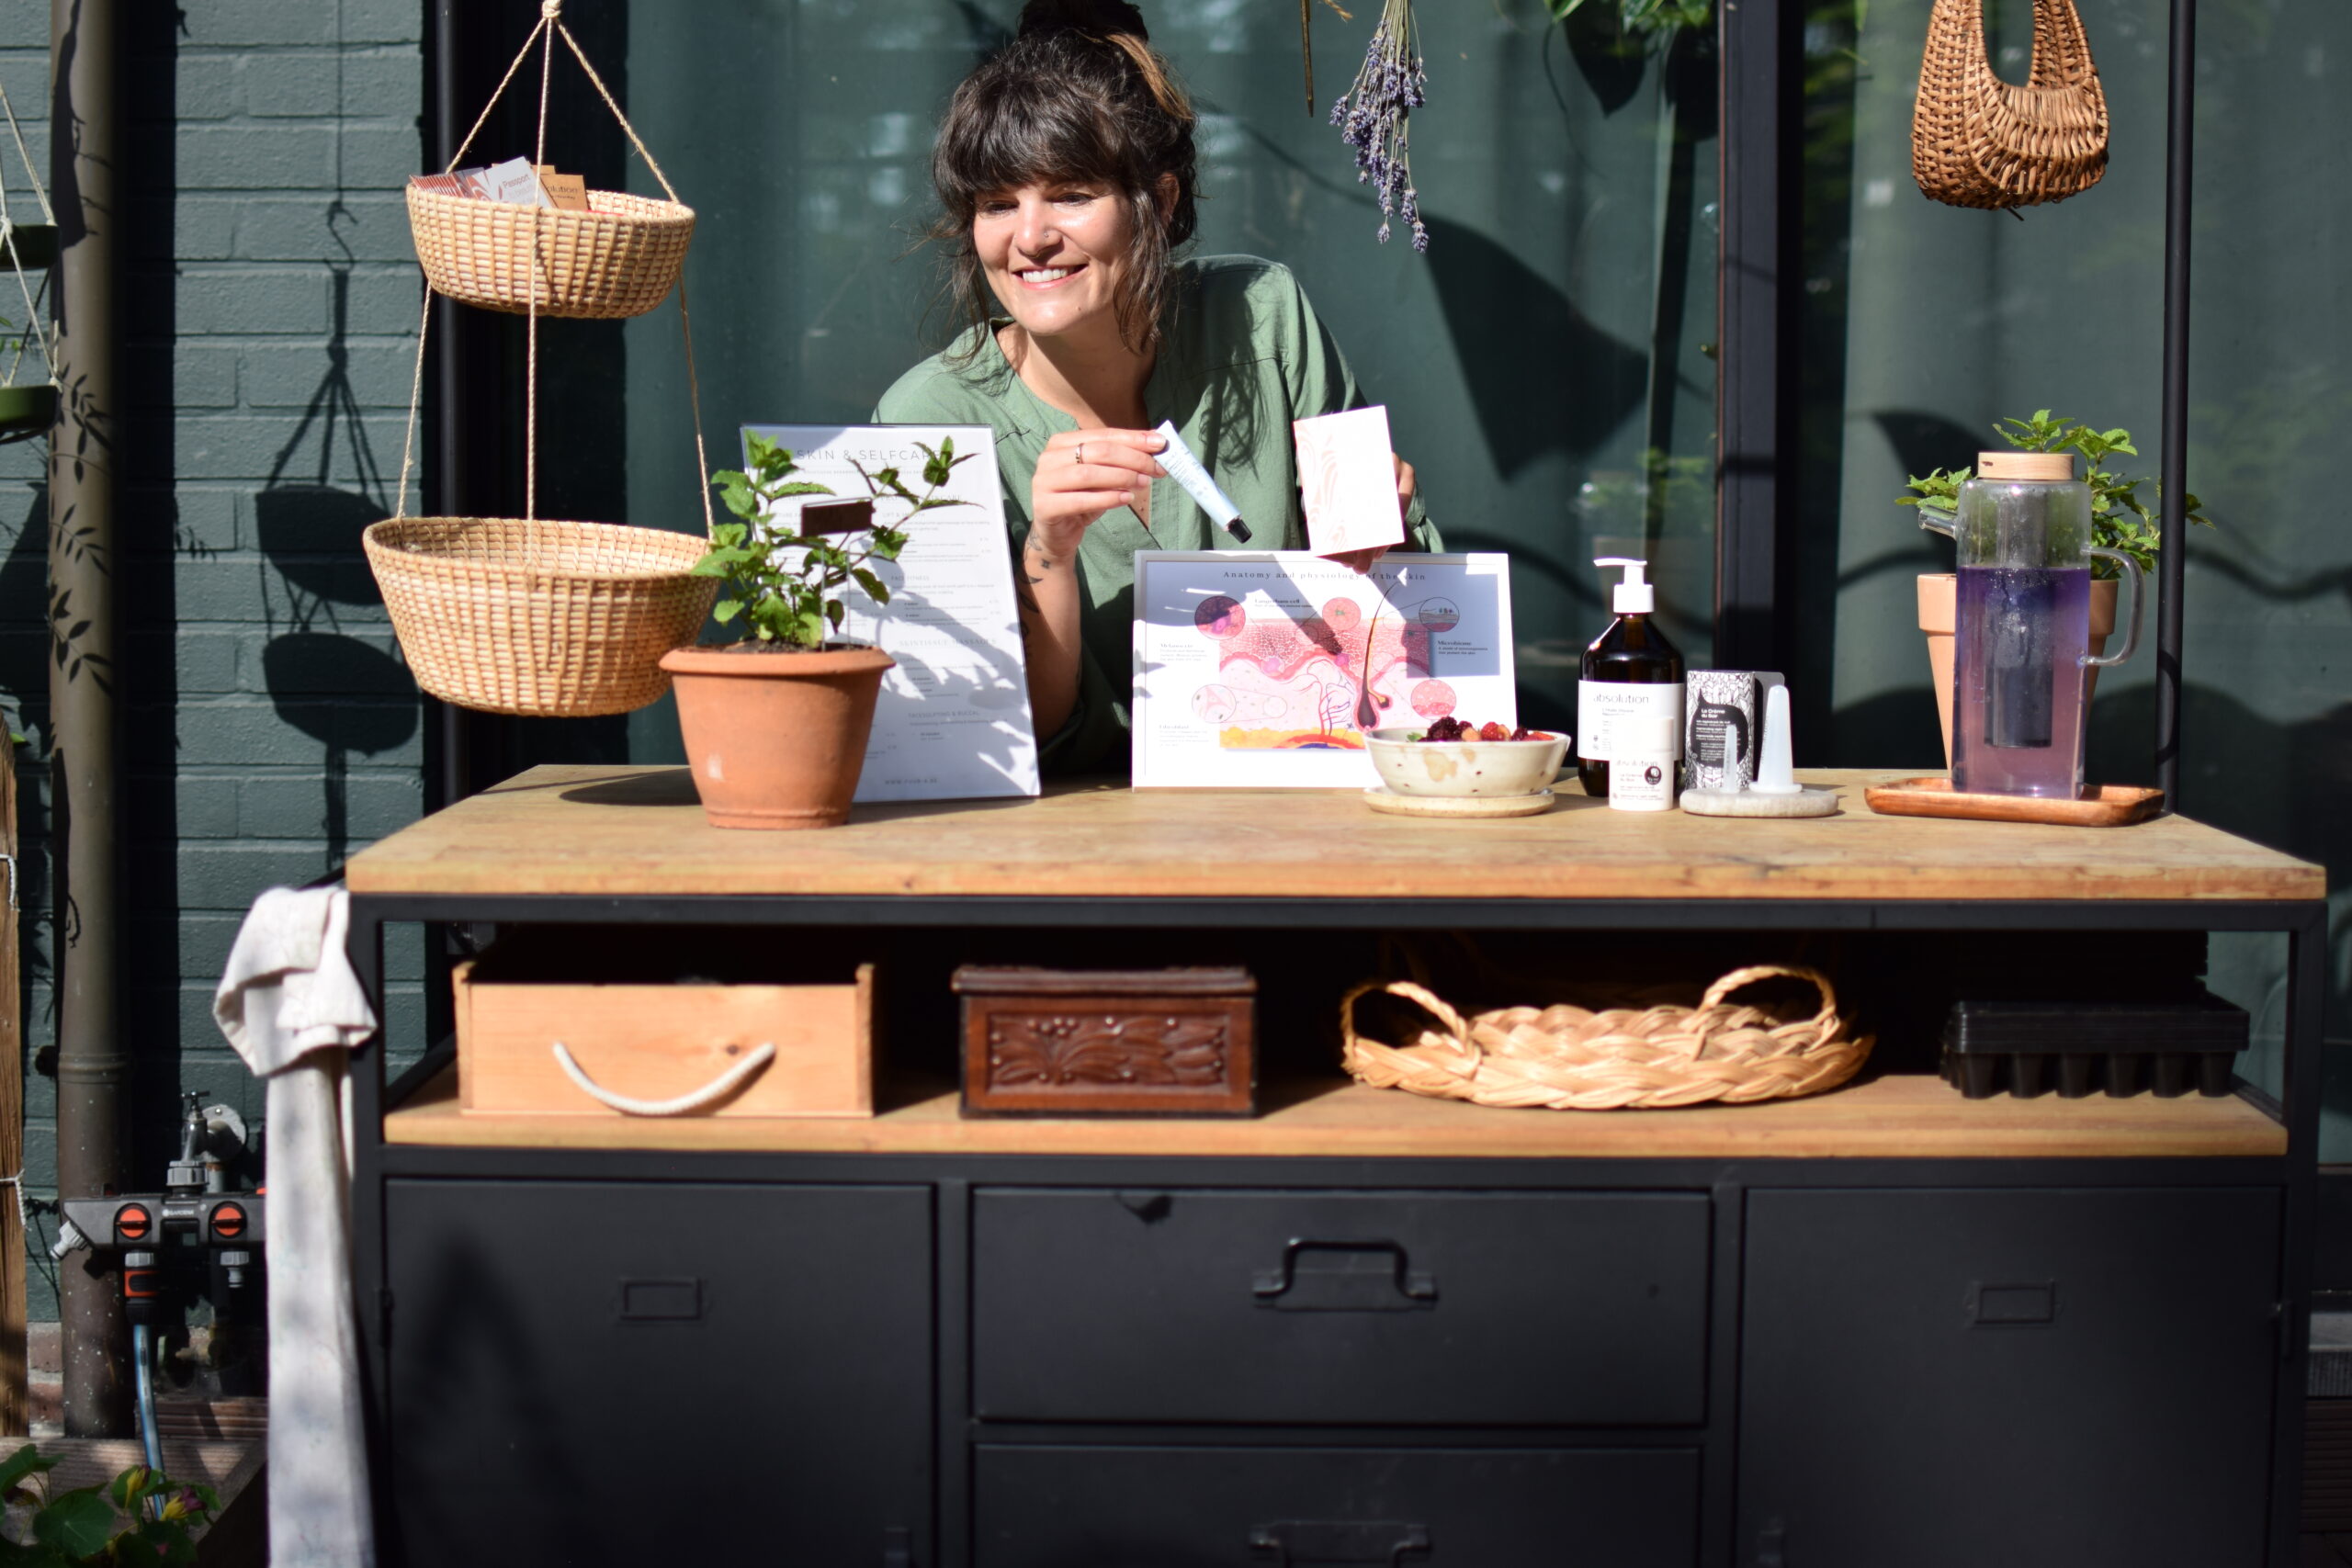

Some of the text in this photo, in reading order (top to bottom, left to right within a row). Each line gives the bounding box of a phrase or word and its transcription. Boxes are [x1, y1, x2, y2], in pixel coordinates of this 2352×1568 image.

[502, 175, 530, 187] Passport
[548, 186, 578, 194] olution
[797, 449, 941, 461] SKIN & SELFCARE
[1224, 571, 1272, 580] Anatomy
[1300, 571, 1360, 581] physiology
[1402, 572, 1425, 581] kin
[1593, 693, 1649, 705] absolution
